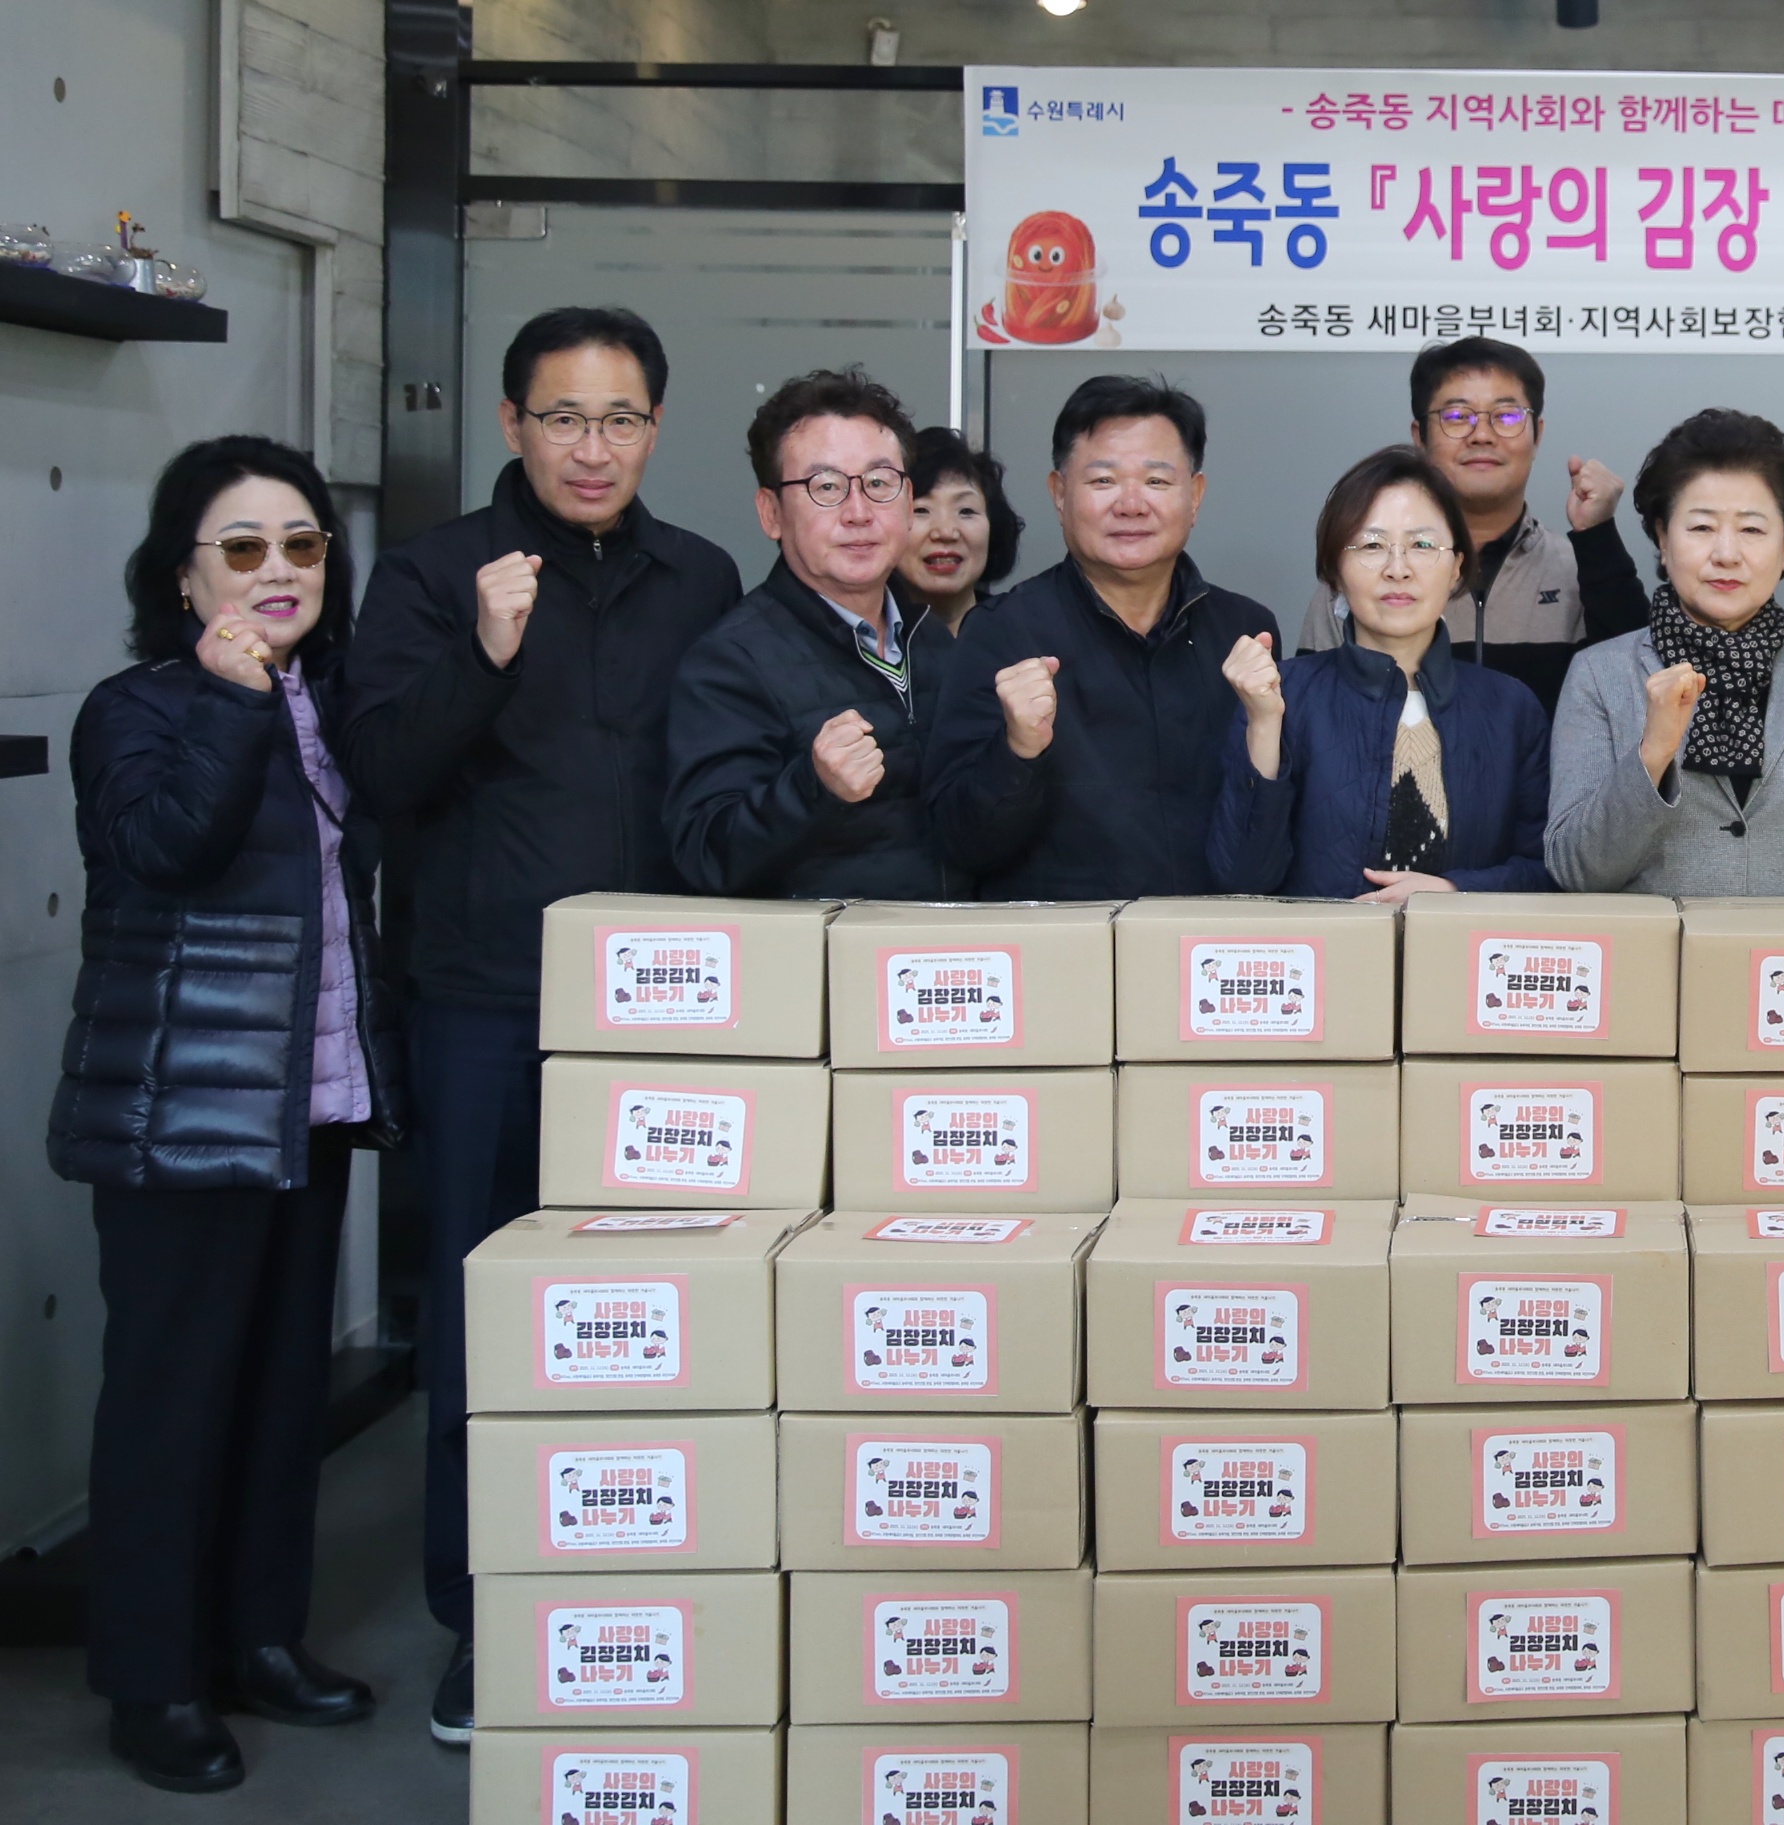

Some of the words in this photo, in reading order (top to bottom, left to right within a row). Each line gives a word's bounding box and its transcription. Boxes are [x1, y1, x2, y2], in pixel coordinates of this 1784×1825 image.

[1028, 101, 1124, 121] 수원특례시
[1306, 93, 1413, 130] 송죽동
[1426, 94, 1606, 132] 지역사회와
[1618, 95, 1760, 133] 함께하는
[1138, 156, 1339, 269] 송죽동
[1638, 166, 1769, 273] 김장
[1258, 304, 1353, 336] 송죽동
[652, 950, 700, 965] 사랑의
[1524, 957, 1572, 974] 사랑의
[636, 968, 700, 984] 김장김치
[934, 970, 982, 985] 사랑의
[1507, 974, 1571, 992] 김장김치
[636, 985, 684, 1002] 나누기
[918, 988, 982, 1004] 김장김치
[1507, 993, 1554, 1009] 나누기
[918, 1006, 967, 1023] 나누기
[665, 1111, 714, 1128] 사랑의
[1246, 1108, 1294, 1123] 사랑의
[1516, 1106, 1563, 1122] 사랑의
[647, 1127, 712, 1146] 김장김치
[1230, 1126, 1293, 1142] 김장김치
[1500, 1124, 1563, 1140] 김장김치
[646, 1146, 695, 1163] 나누기
[1230, 1143, 1277, 1160] 나누기
[1500, 1141, 1547, 1158] 나누기
[594, 1302, 646, 1318] 사랑의
[1214, 1308, 1265, 1325] 사랑의
[1518, 1300, 1569, 1317] 사랑의
[577, 1321, 646, 1339] 김장김치
[1196, 1327, 1265, 1343] 김장김치
[1500, 1319, 1568, 1336] 김장김치
[577, 1340, 629, 1358] 나누기
[1197, 1345, 1248, 1362] 나누기
[1500, 1338, 1551, 1355] 나누기
[906, 1462, 958, 1479] 사랑의
[1222, 1461, 1273, 1478] 사랑의
[888, 1481, 957, 1498] 김장김치
[1204, 1481, 1272, 1497] 김장김치
[888, 1500, 940, 1517] 나누기
[1204, 1499, 1255, 1516] 나누기
[924, 1619, 976, 1635] 사랑의
[1528, 1616, 1578, 1632] 사랑의
[598, 1626, 650, 1642] 사랑의
[907, 1638, 976, 1655] 김장김치
[1510, 1635, 1578, 1652] 김장김치
[580, 1645, 650, 1663] 김장김치
[1510, 1653, 1561, 1671] 나누기
[581, 1664, 633, 1682] 나누기
[907, 1657, 959, 1675] 나누기
[1229, 1761, 1280, 1778] 사랑의
[1211, 1780, 1279, 1797] 김장김치
[1212, 1799, 1263, 1816] 나누기
